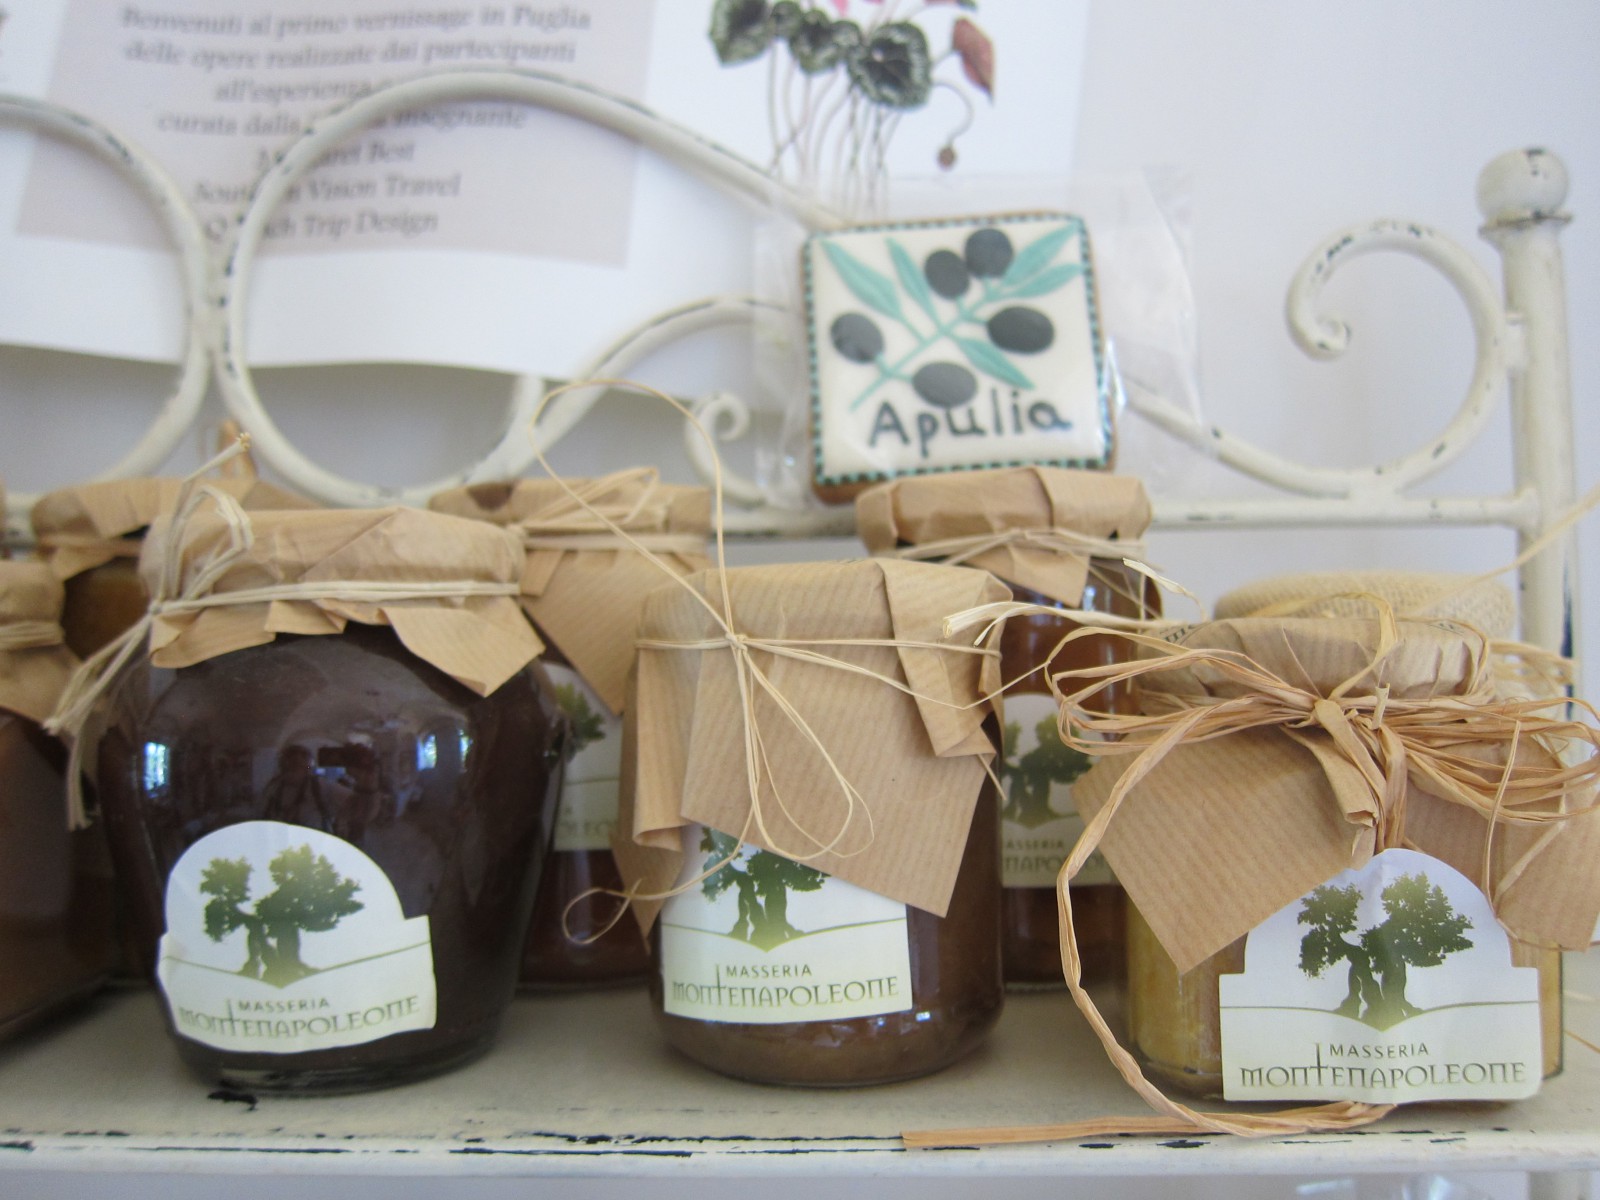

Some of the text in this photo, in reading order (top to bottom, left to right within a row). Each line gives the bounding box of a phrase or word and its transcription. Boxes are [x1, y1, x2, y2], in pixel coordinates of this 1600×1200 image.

[121, 5, 592, 41] Benvenuti al primo vernissage in Puglia
[125, 37, 577, 72] delle opere realizzate dai partecipanti
[157, 115, 238, 135] curata
[386, 170, 463, 198] Travel
[356, 207, 440, 238] Design
[868, 384, 1072, 459] Apulia
[672, 963, 900, 1008] MONTENAPOLEONE
[726, 963, 813, 979] MASSERIA
[177, 995, 419, 1038] MONTENAPOLEONE
[238, 997, 330, 1014] MASSERIA
[1240, 1042, 1528, 1089] MONTENAPOLEONE
[1329, 1042, 1430, 1059] MASSERIA
